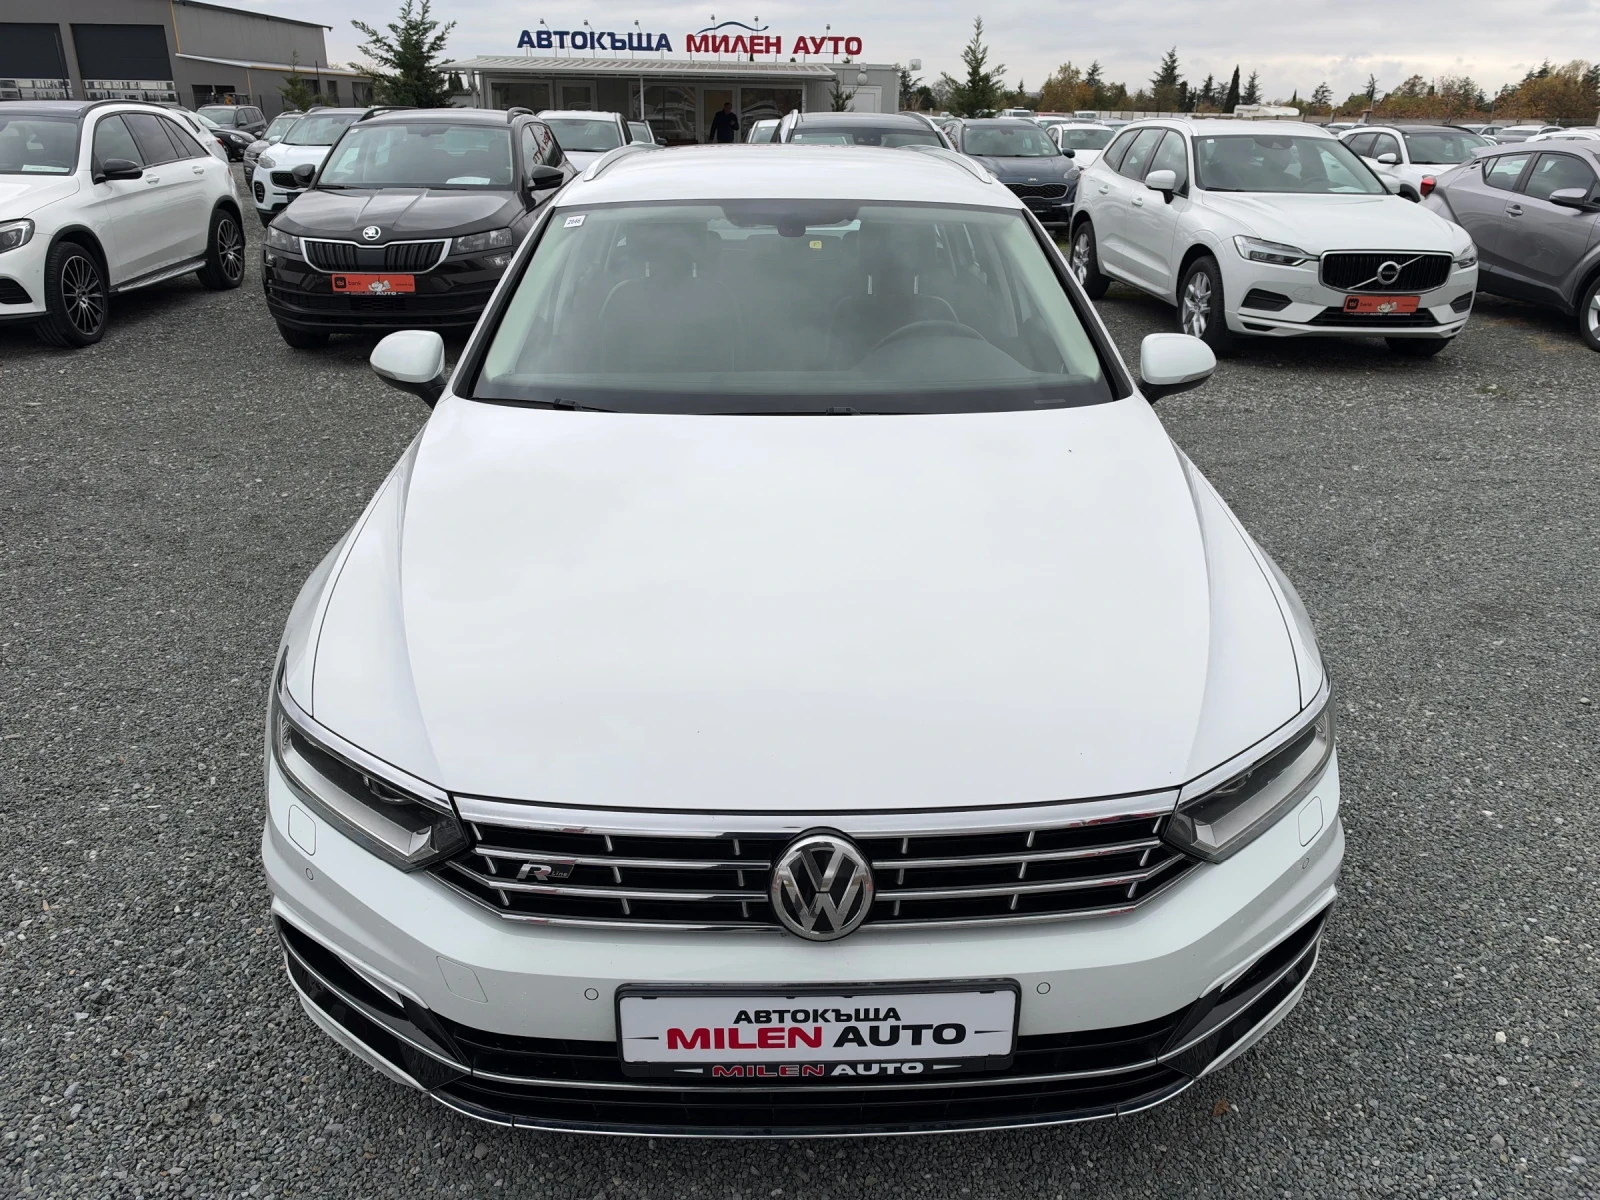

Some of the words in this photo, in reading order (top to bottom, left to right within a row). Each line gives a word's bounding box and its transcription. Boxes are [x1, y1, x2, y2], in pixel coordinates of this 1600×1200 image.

[517, 29, 673, 52] АВТОКЪЩА
[686, 33, 782, 55] МИЛЕН
[792, 35, 862, 56] АУТО
[516, 863, 552, 881] R
[733, 1007, 902, 1024] АВТОКЪЩА
[667, 1026, 822, 1050] MILEN
[833, 1023, 967, 1048] AUTO
[712, 1063, 825, 1078] MILEN
[831, 1062, 924, 1076] AUTO
